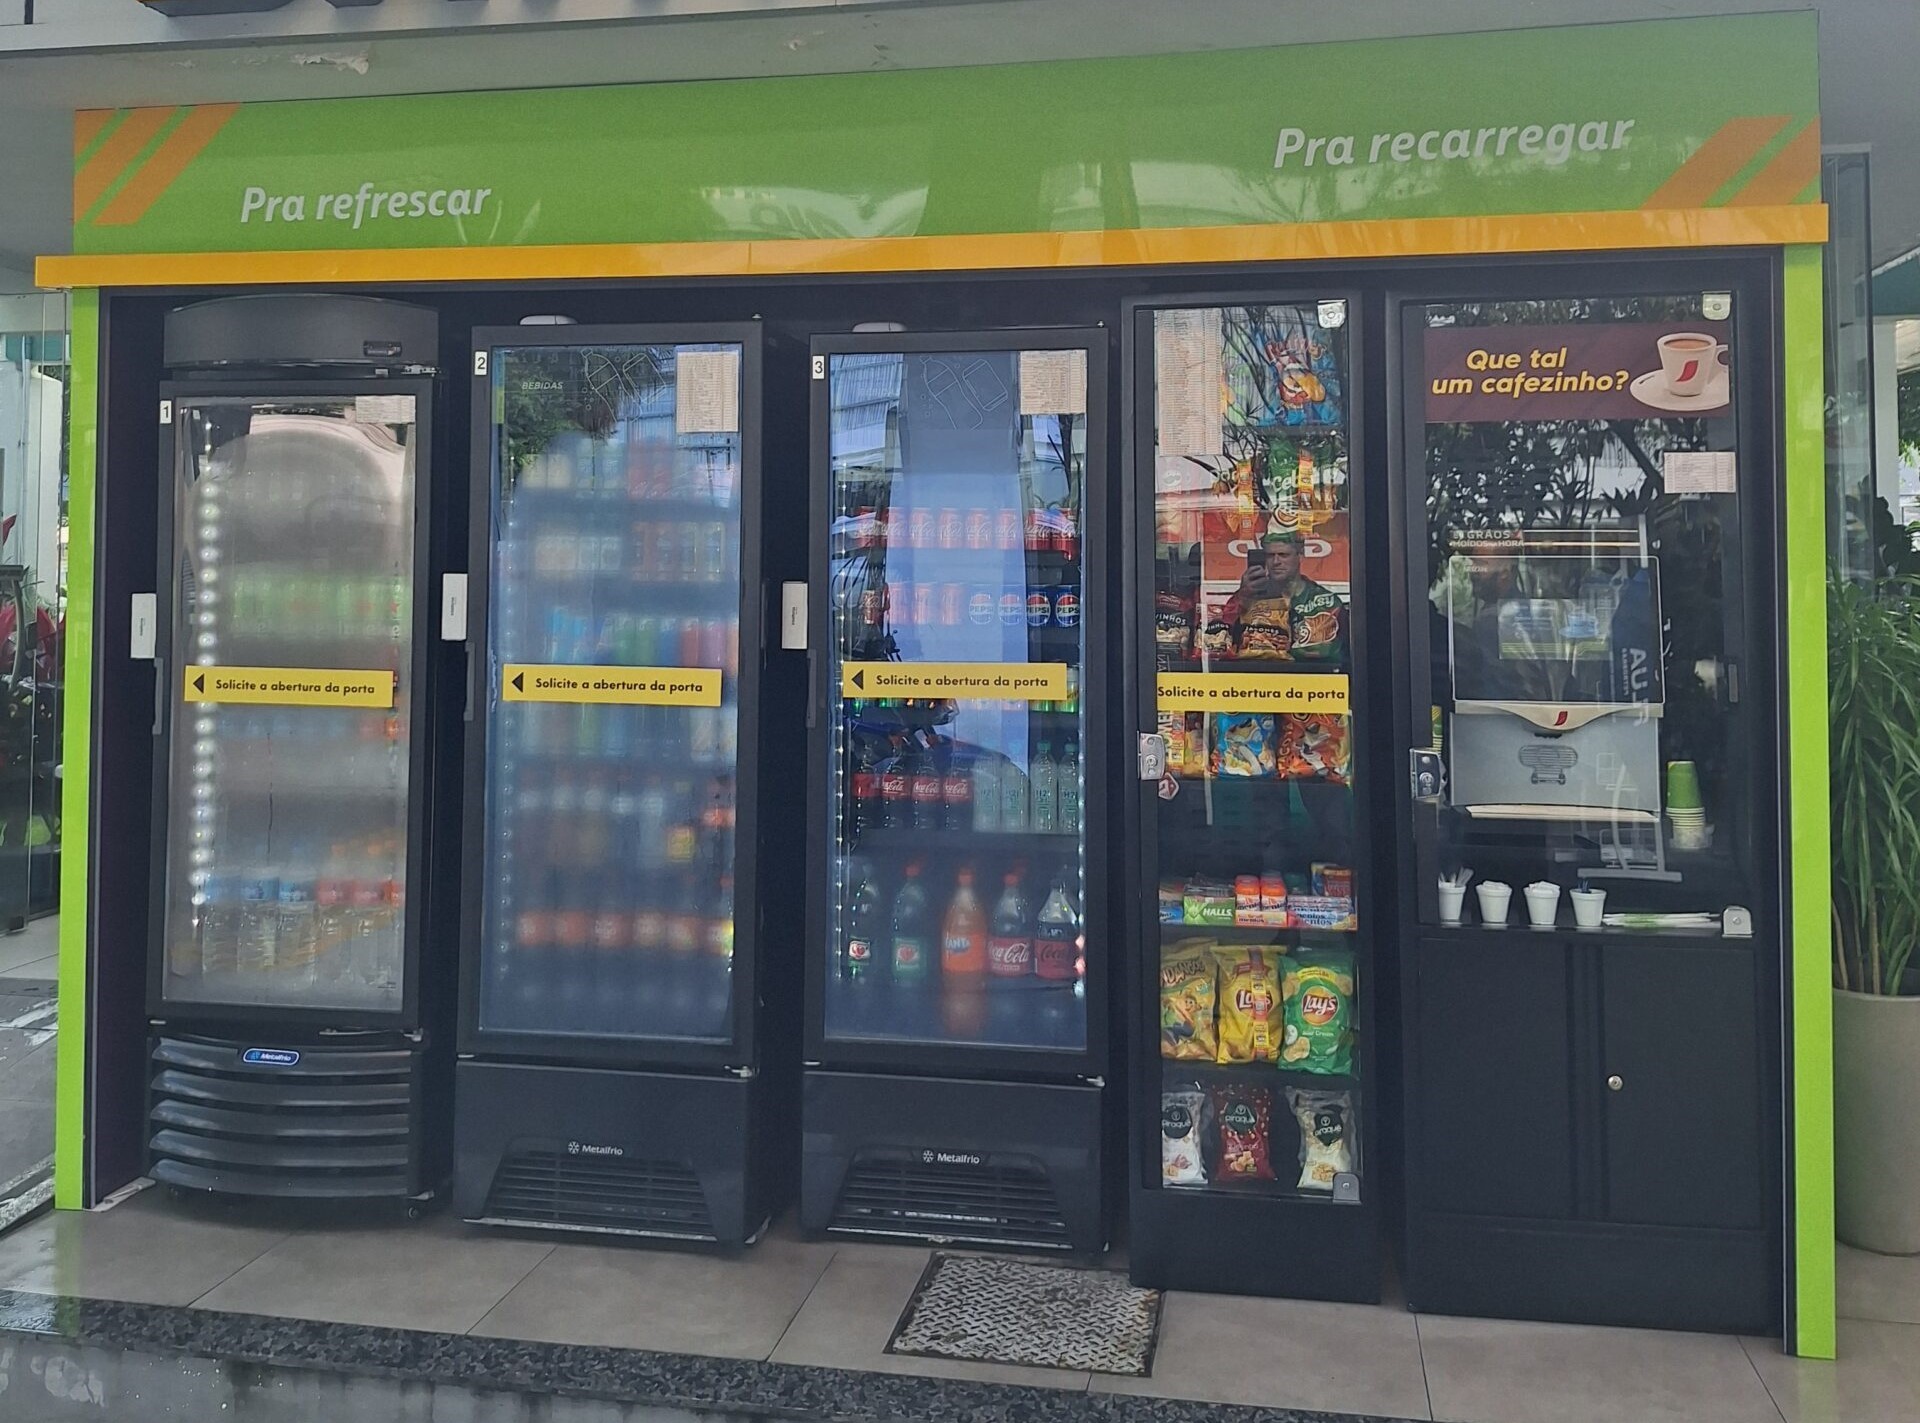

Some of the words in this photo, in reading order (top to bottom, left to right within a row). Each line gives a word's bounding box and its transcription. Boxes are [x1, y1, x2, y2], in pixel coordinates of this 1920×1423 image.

[1273, 128, 1354, 168] Pra
[1368, 119, 1635, 165] recarregar
[240, 187, 305, 223] Pra
[316, 182, 492, 229] refrescar
[477, 356, 486, 370] 2
[1466, 350, 1521, 371] Que
[1530, 347, 1567, 369] tal
[815, 360, 823, 374] 3
[522, 381, 564, 390] BEBIDAS
[1432, 377, 1473, 394] um
[1481, 370, 1629, 398] cafezinho?
[1056, 606, 1080, 614] PEPS
[215, 679, 256, 690] Solicite
[271, 681, 321, 692] abertura
[325, 682, 339, 693] da
[343, 683, 375, 696] porta
[536, 678, 578, 689] Solicite
[594, 679, 646, 691] abertura
[650, 680, 665, 691] da
[670, 681, 703, 694] porta
[876, 675, 919, 686] Solicite
[936, 675, 989, 686] abertura
[994, 676, 1009, 686] da
[1014, 677, 1048, 690] porta
[1158, 686, 1204, 698] Solicite
[1209, 690, 1217, 698] a
[1222, 687, 1281, 698] abertura
[1286, 687, 1303, 699] da
[1308, 689, 1345, 702] porta
[1203, 908, 1233, 917] HALLS
[1303, 995, 1337, 1016] Lay's
[582, 1144, 623, 1156] Metalfrio
[937, 1152, 980, 1164] Metalfrio
